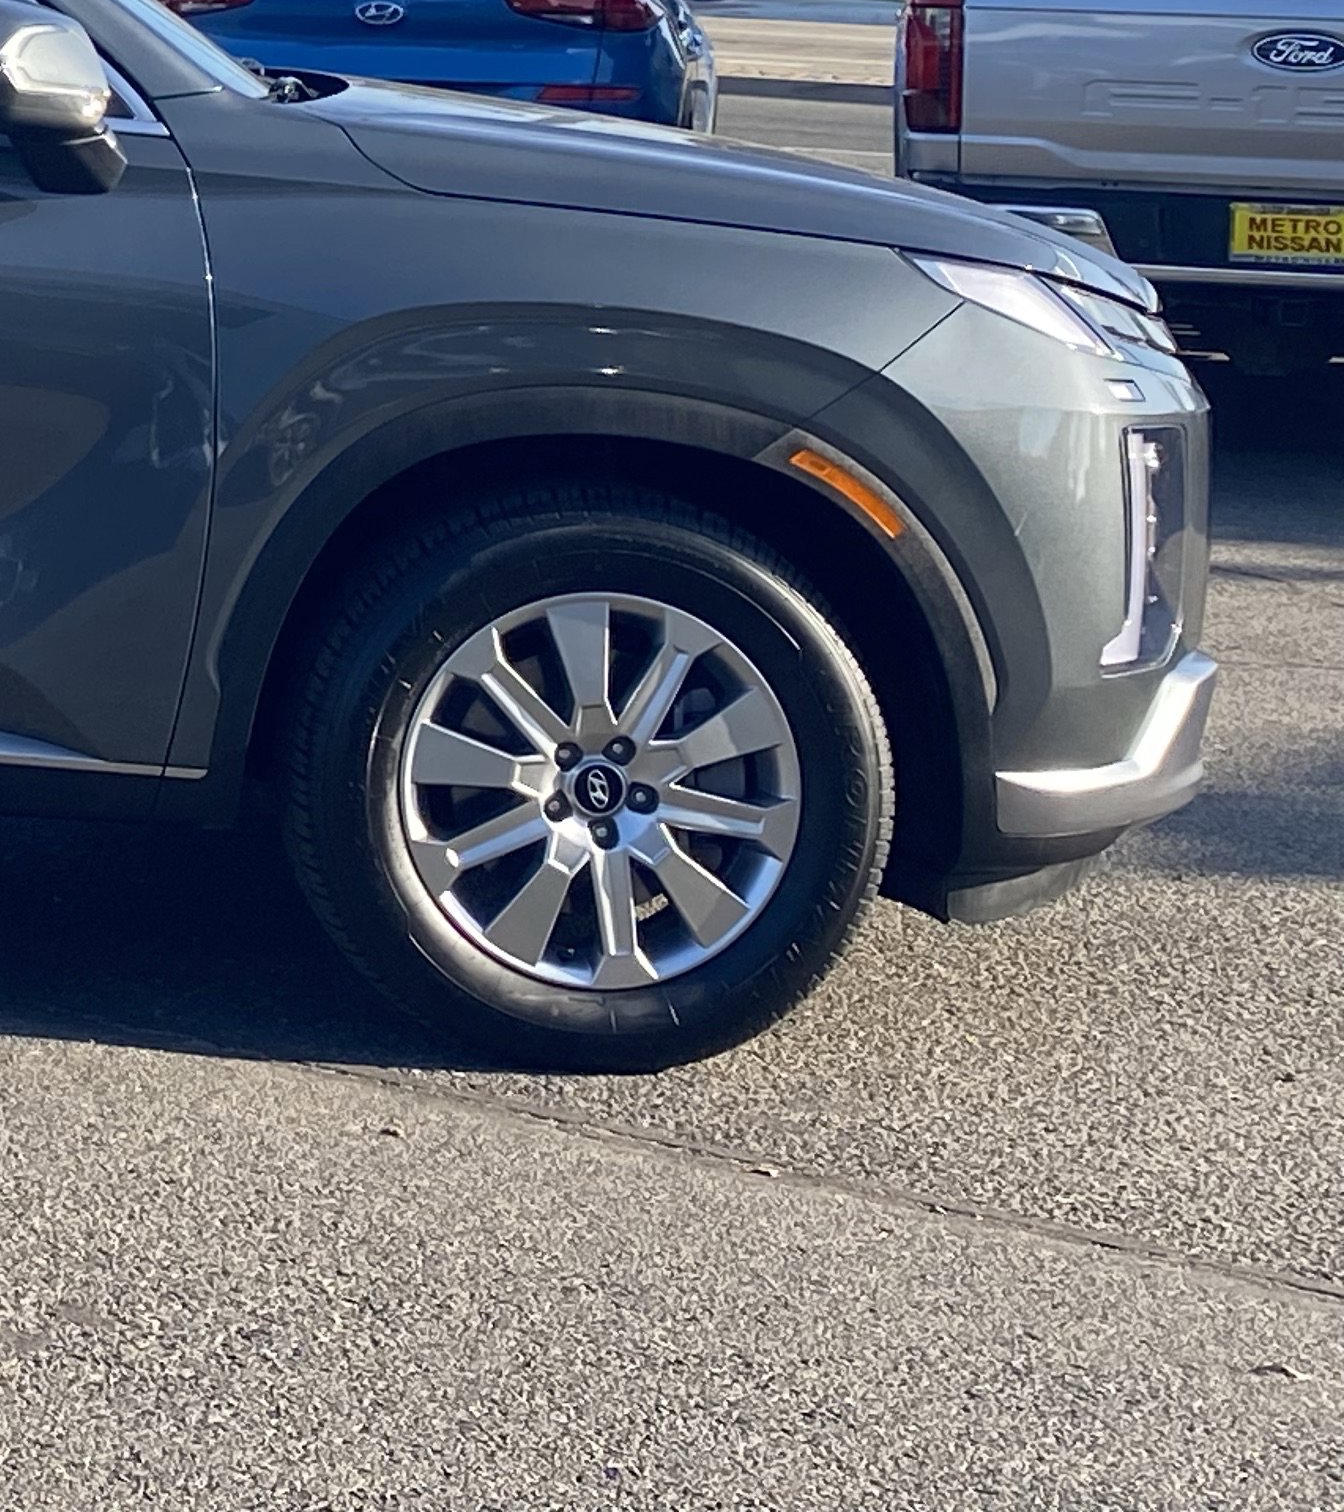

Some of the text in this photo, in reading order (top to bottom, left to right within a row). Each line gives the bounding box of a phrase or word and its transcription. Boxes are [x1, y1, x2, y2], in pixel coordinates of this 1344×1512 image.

[1269, 38, 1334, 65] Ford
[1248, 216, 1343, 236] METRO
[1247, 234, 1343, 254] NISSAN
